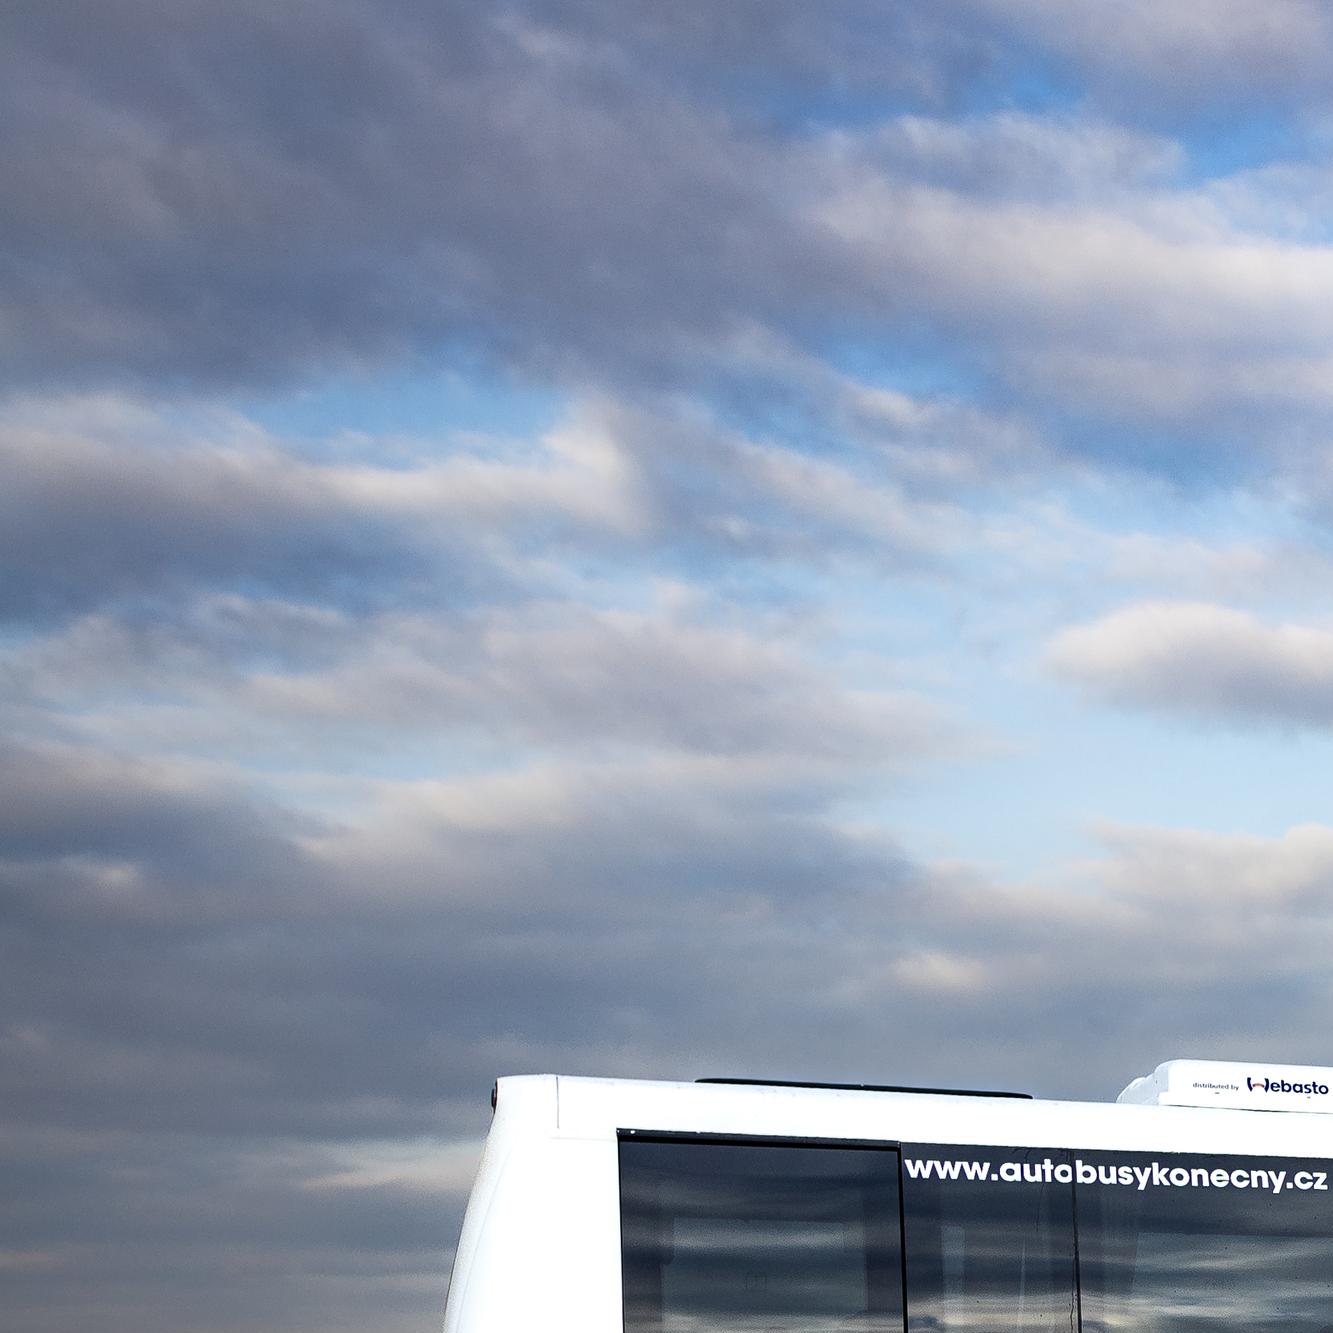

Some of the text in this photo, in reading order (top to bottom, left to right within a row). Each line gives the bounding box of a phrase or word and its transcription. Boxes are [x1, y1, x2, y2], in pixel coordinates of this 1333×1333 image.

[1193, 1082, 1240, 1092] distributed by
[1247, 1077, 1329, 1095] Webasto
[904, 1158, 1329, 1194] www.autobusykonecny.cz
